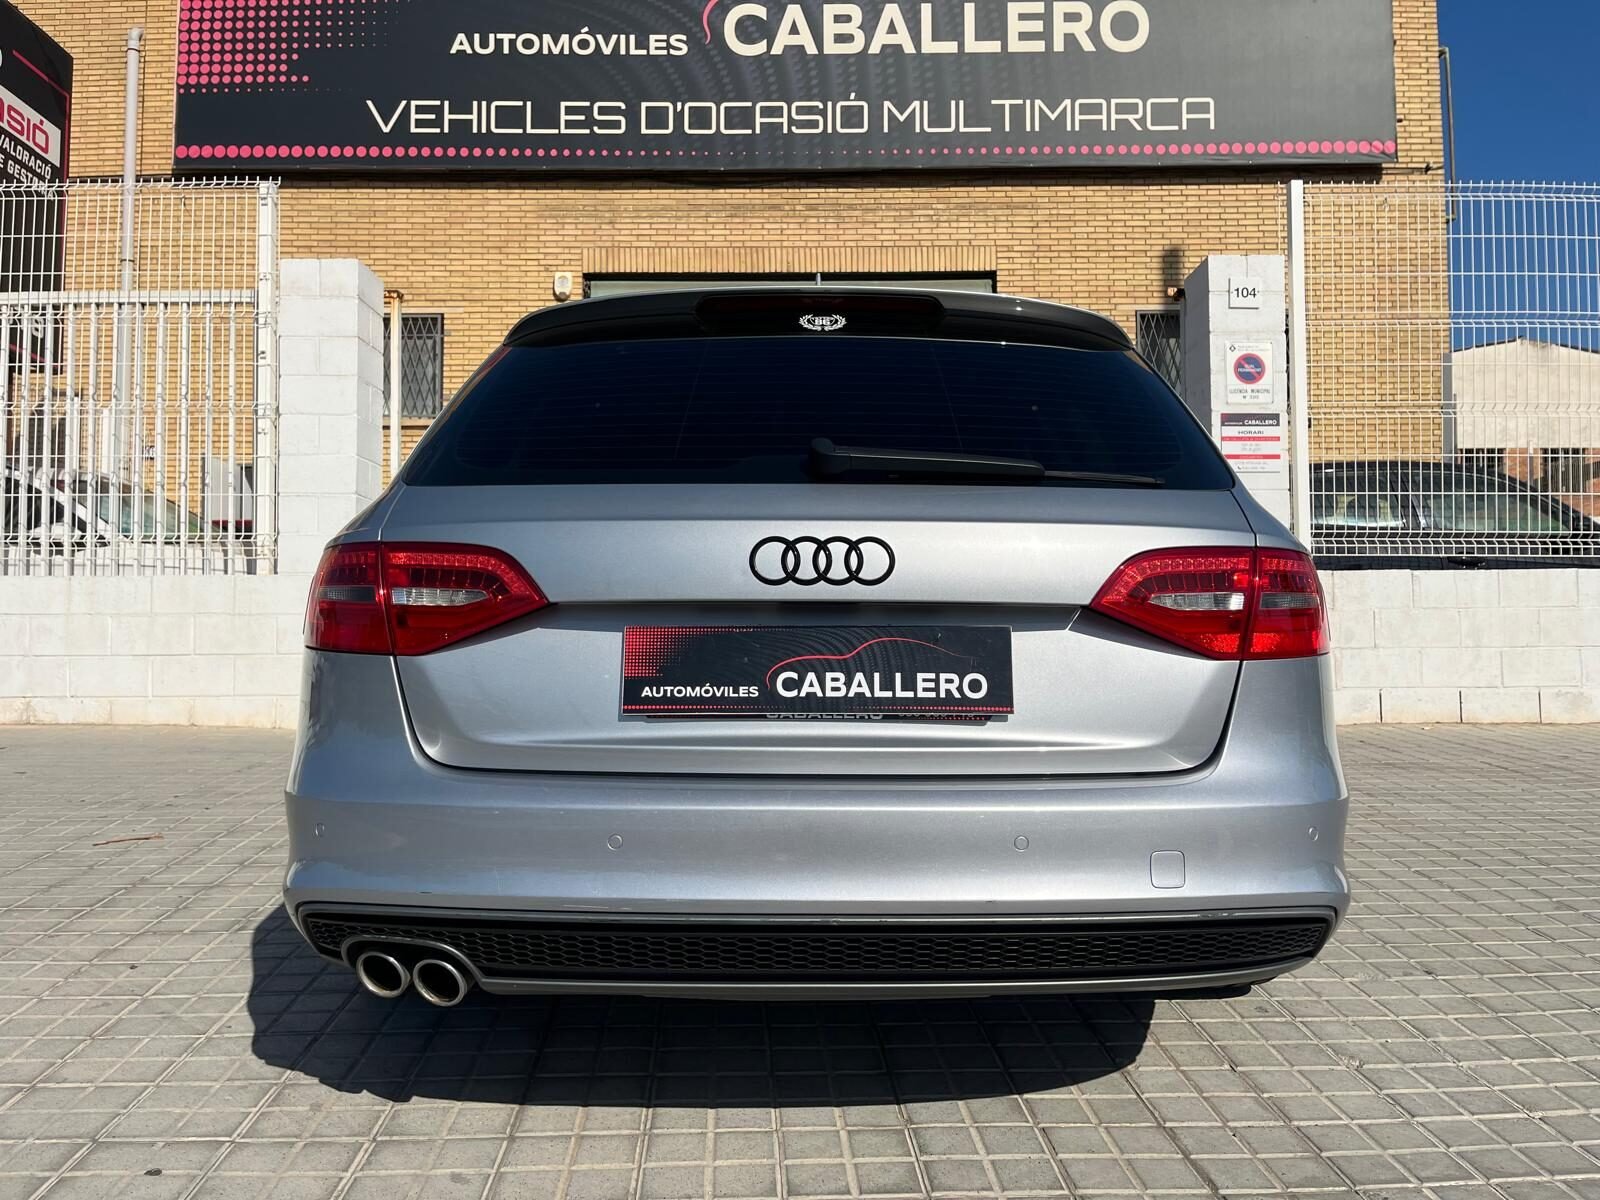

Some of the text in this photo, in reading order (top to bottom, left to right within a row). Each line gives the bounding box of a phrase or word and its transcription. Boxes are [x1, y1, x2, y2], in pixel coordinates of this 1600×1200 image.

[449, 0, 1150, 58] AUTOMÓVILES CABALLERO
[366, 100, 626, 135] VEHICLES
[883, 97, 1215, 133] MULTIMARCA
[1234, 287, 1257, 298] 104
[641, 671, 988, 700] AUTOMÓVILES CABALLERO
